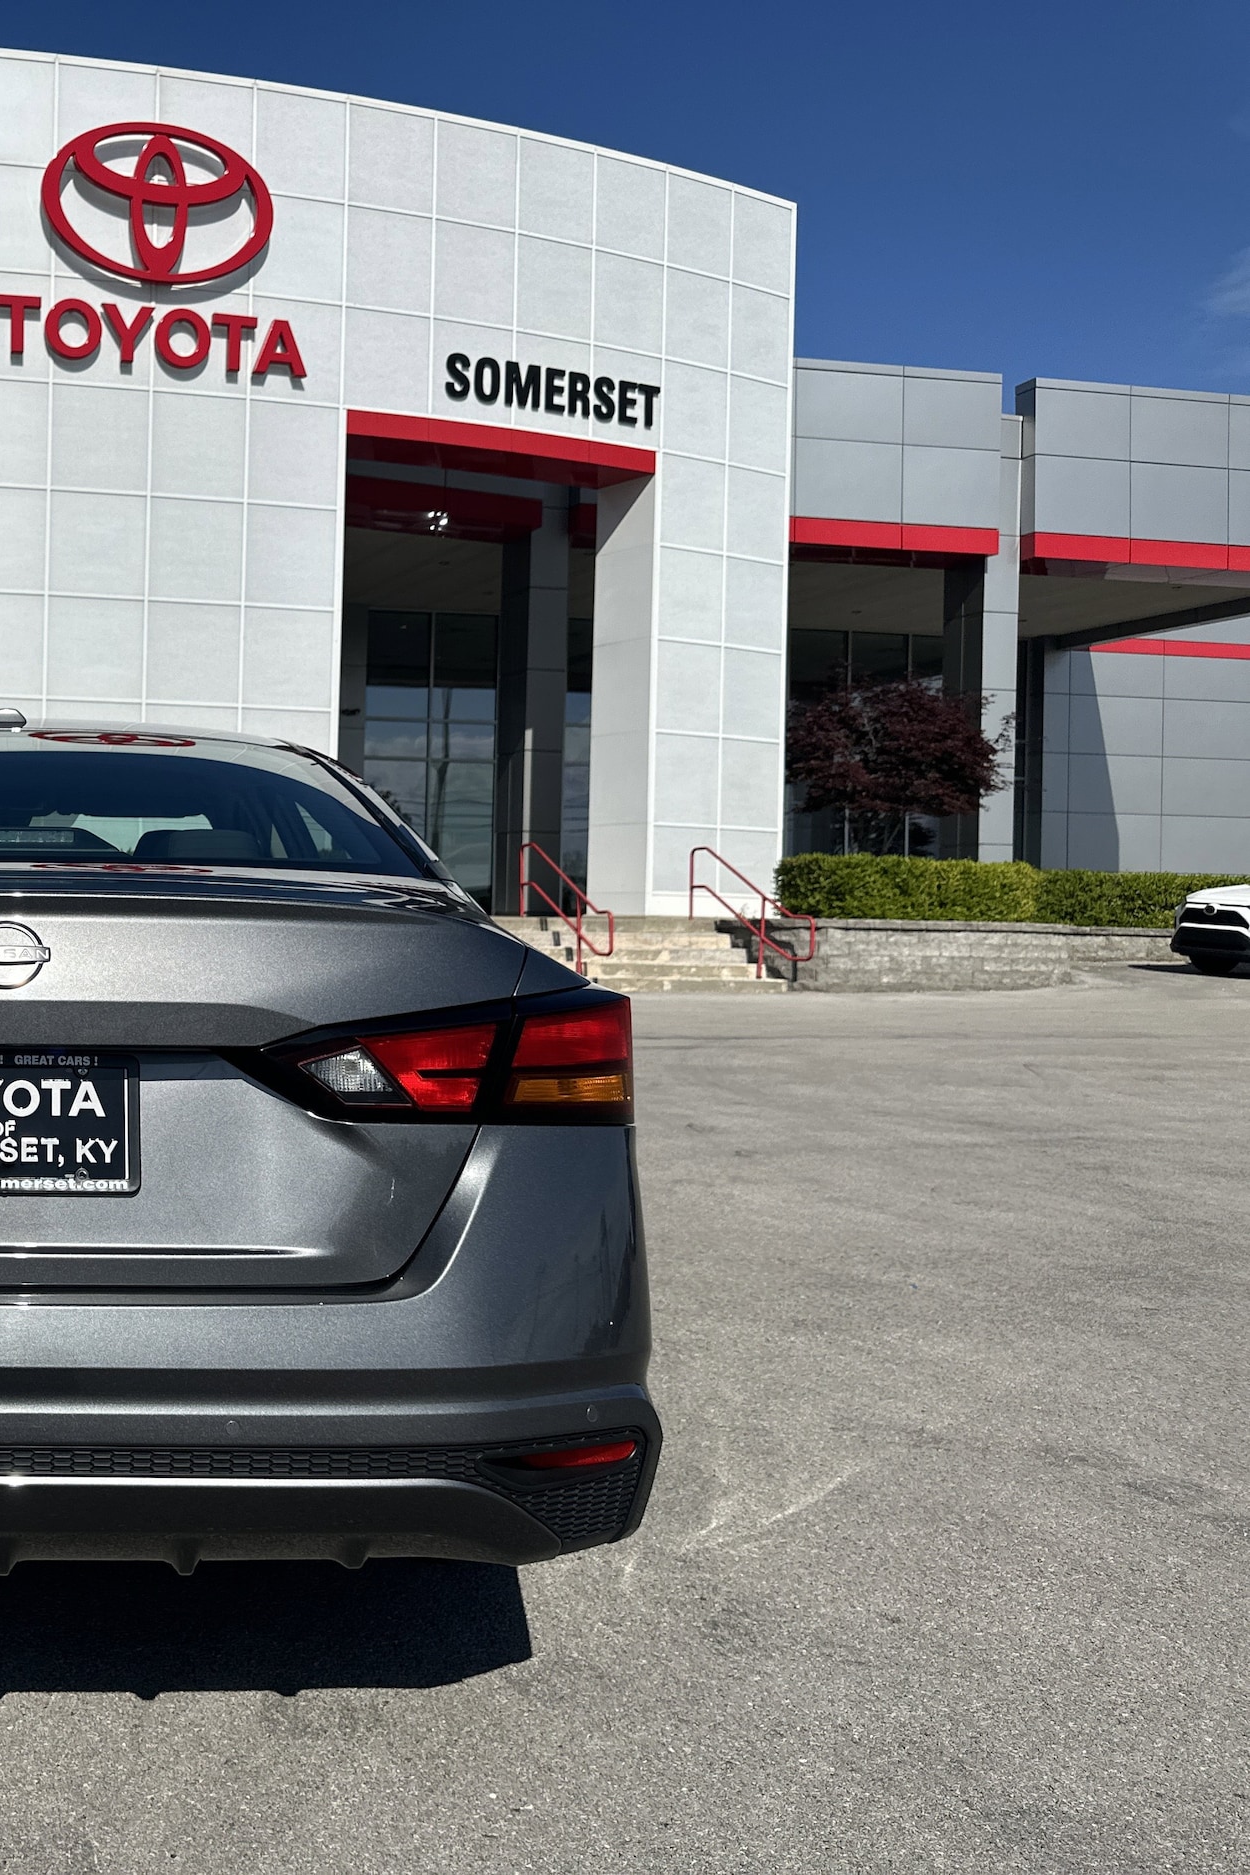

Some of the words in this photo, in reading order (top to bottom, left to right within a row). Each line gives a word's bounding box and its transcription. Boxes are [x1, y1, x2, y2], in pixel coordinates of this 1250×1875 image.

[445, 352, 661, 428] SOMERSET
[14, 1055, 56, 1066] GREAT
[75, 1138, 118, 1163] KY
